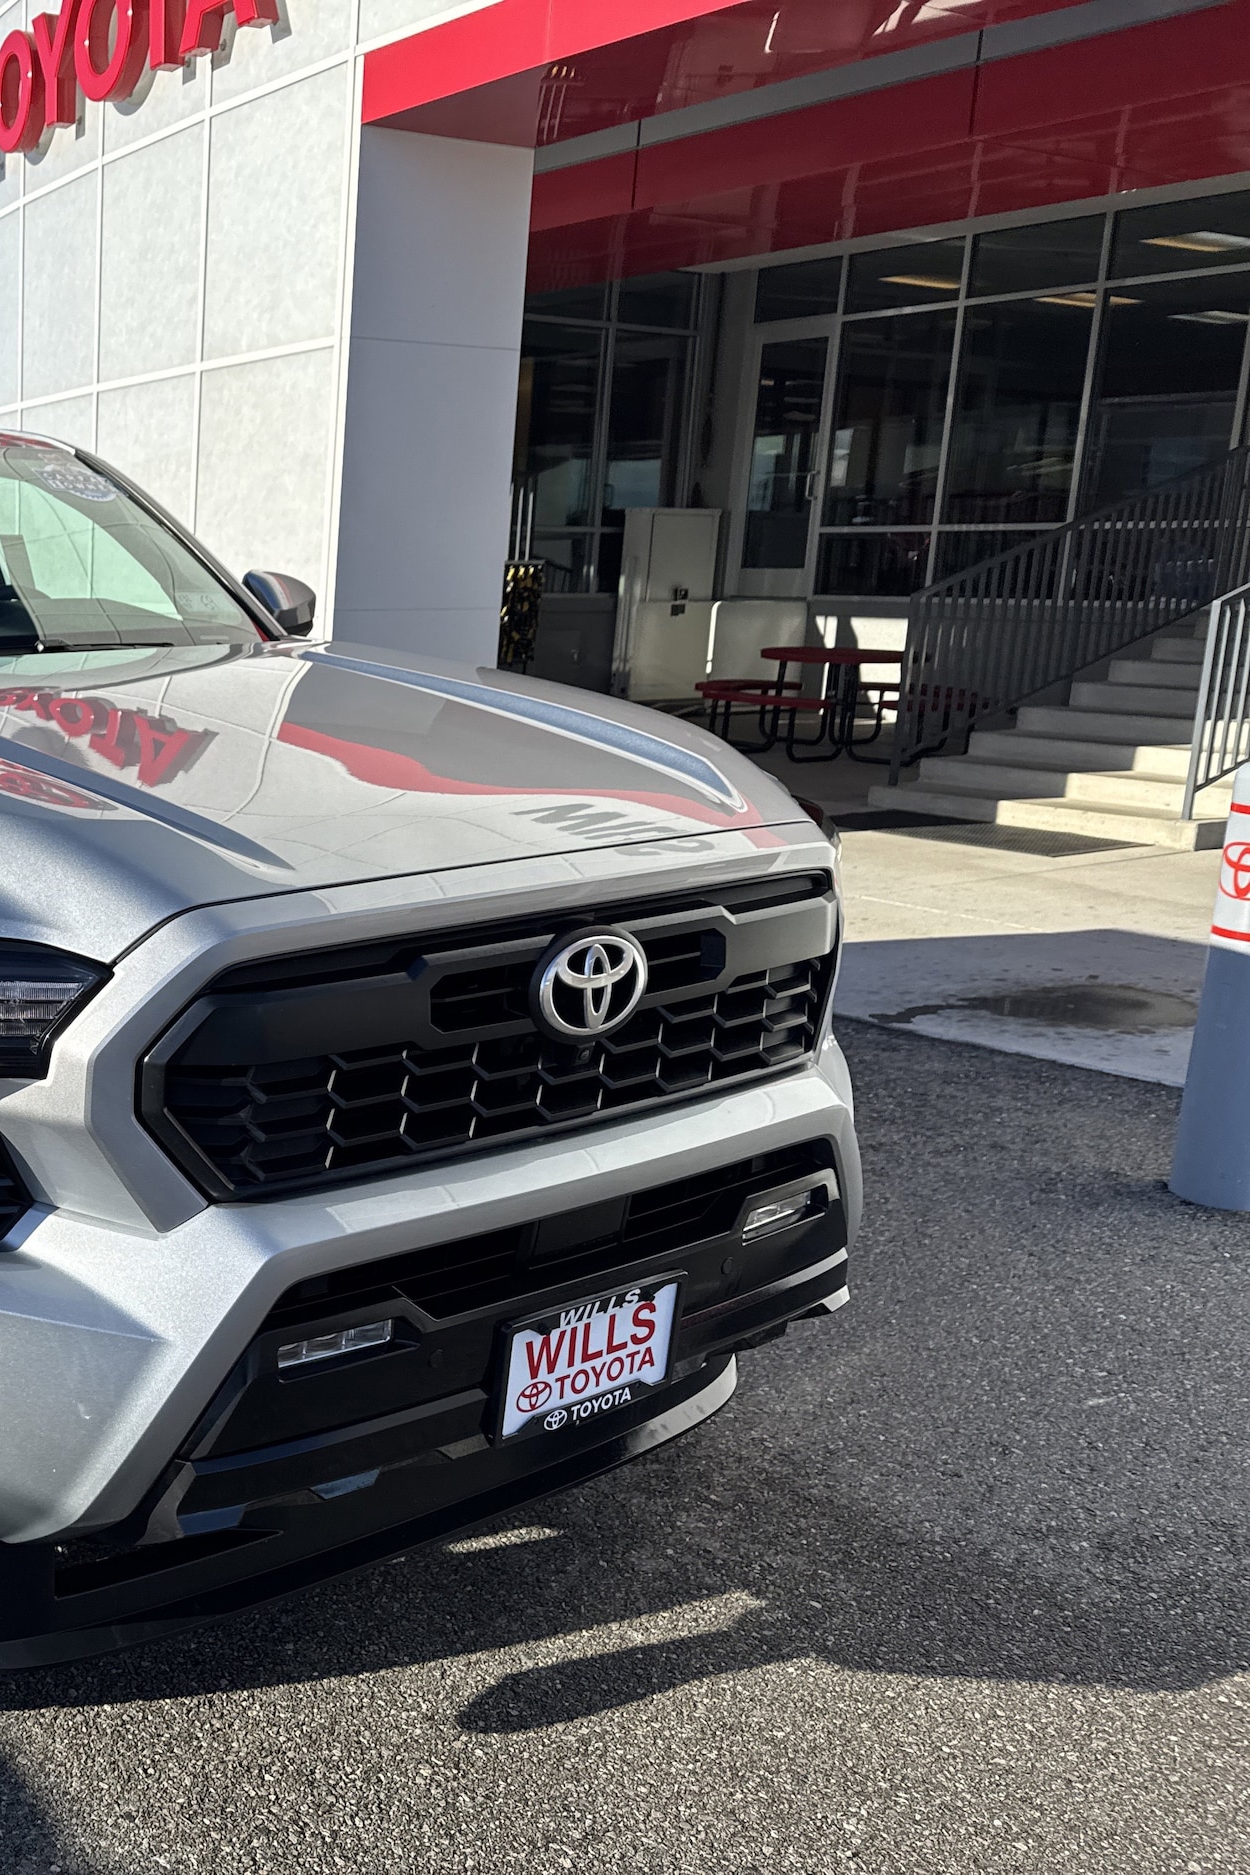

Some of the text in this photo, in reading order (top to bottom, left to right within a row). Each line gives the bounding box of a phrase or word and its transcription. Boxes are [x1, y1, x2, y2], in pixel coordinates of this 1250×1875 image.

[559, 1288, 641, 1328] WILLS
[525, 1301, 657, 1380] WILLS
[554, 1346, 655, 1399] TOYOTA
[571, 1387, 632, 1420] TOYOTA
